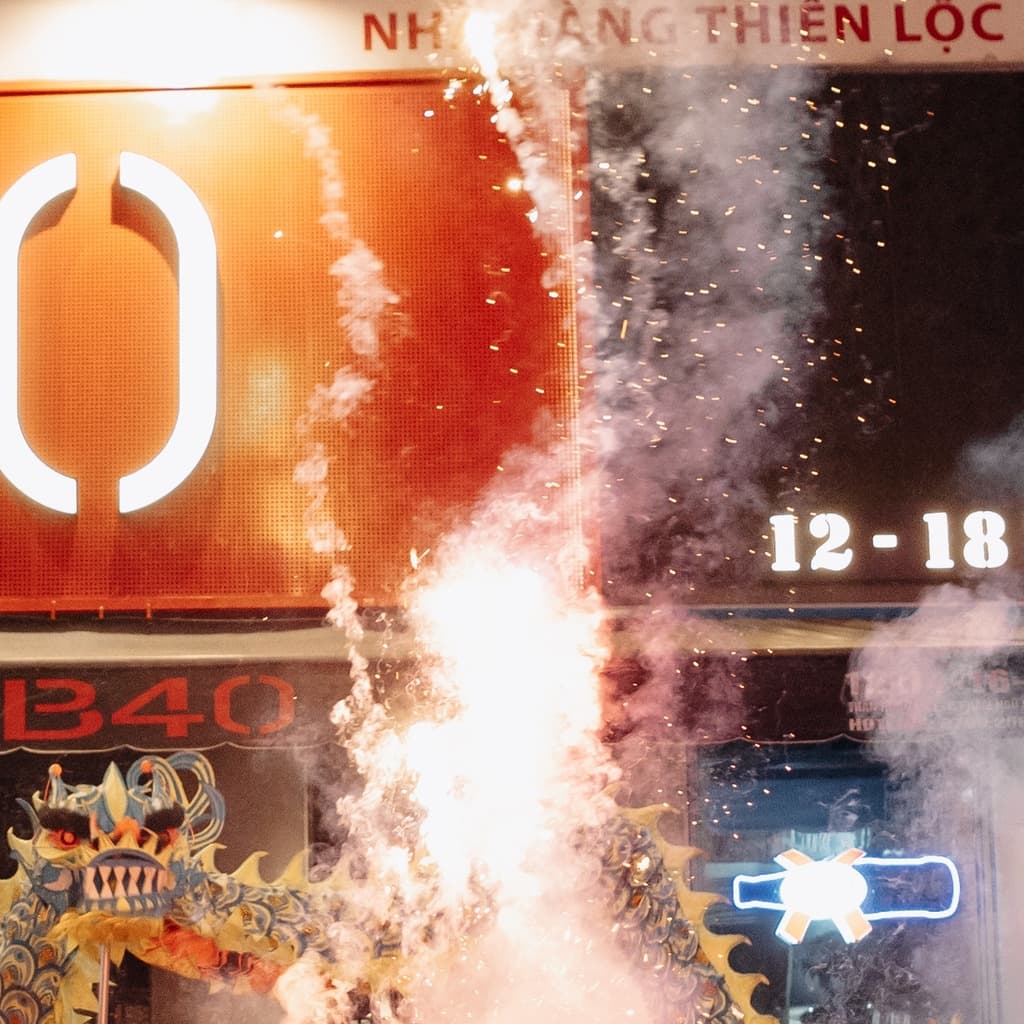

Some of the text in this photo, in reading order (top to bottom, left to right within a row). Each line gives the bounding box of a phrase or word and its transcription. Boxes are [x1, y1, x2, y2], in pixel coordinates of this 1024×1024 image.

[363, 11, 479, 50] NH
[769, 512, 853, 571] 12
[923, 510, 1009, 569] 18
[3, 675, 296, 740] B40
